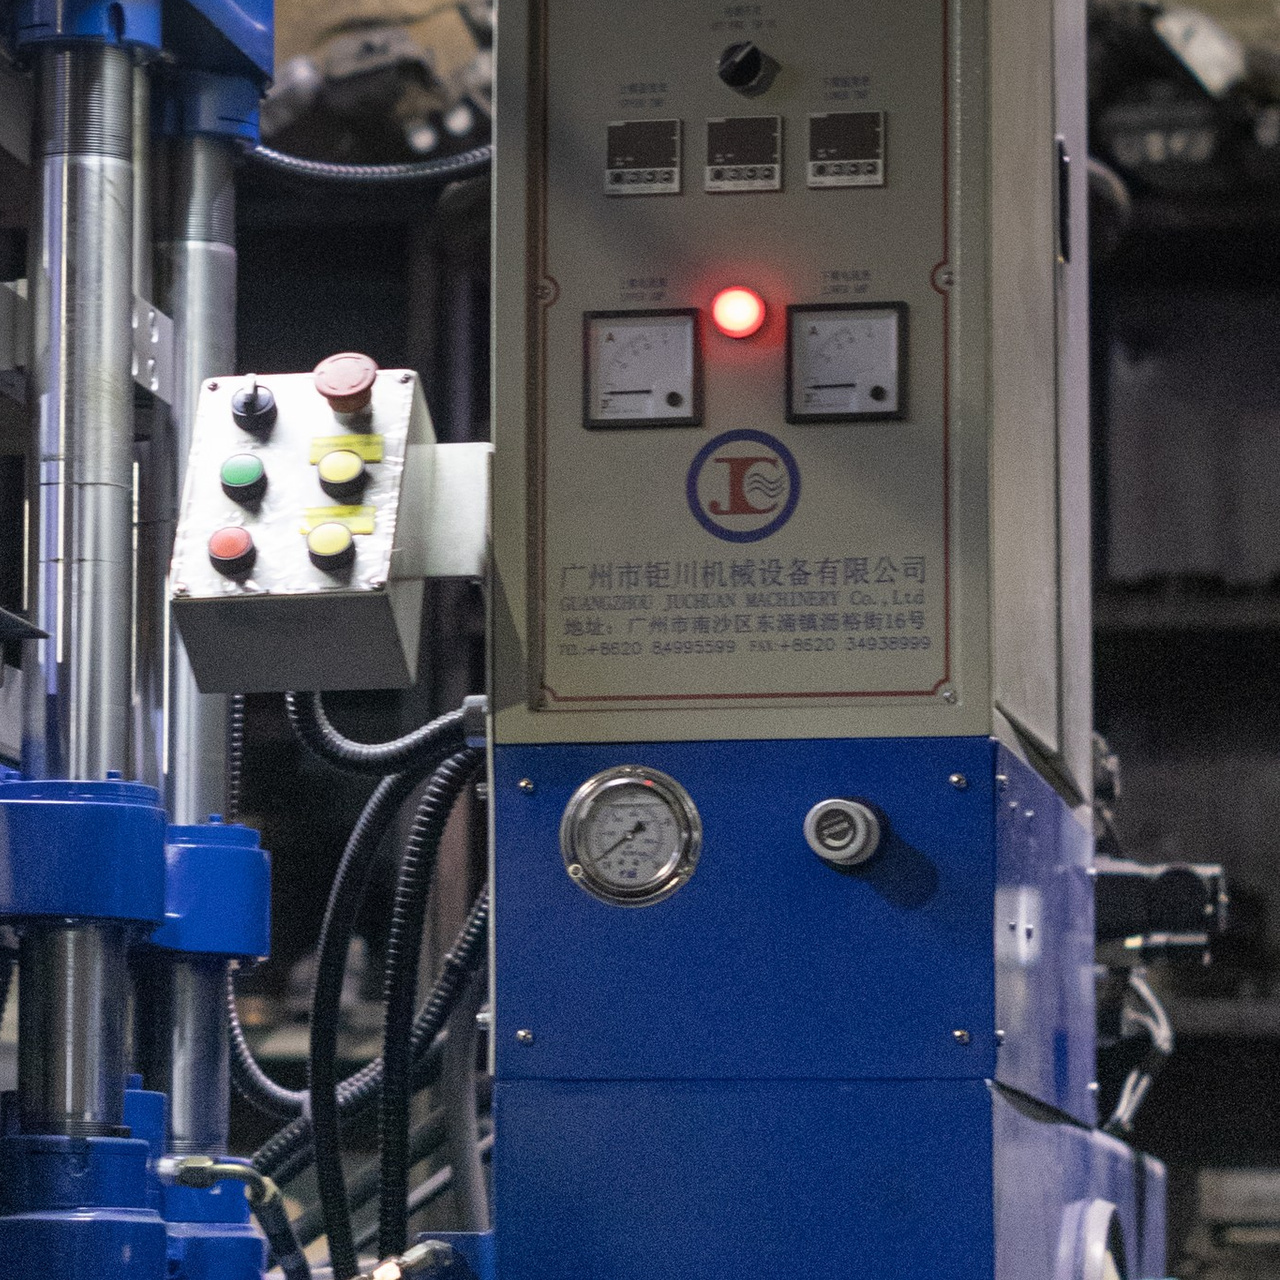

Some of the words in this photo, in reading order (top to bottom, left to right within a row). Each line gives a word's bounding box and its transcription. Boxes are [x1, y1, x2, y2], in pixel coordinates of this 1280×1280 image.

[560, 594, 654, 612] GUANGZHOU
[663, 593, 737, 611] JUCHUAN
[746, 590, 839, 608] MACHINERY
